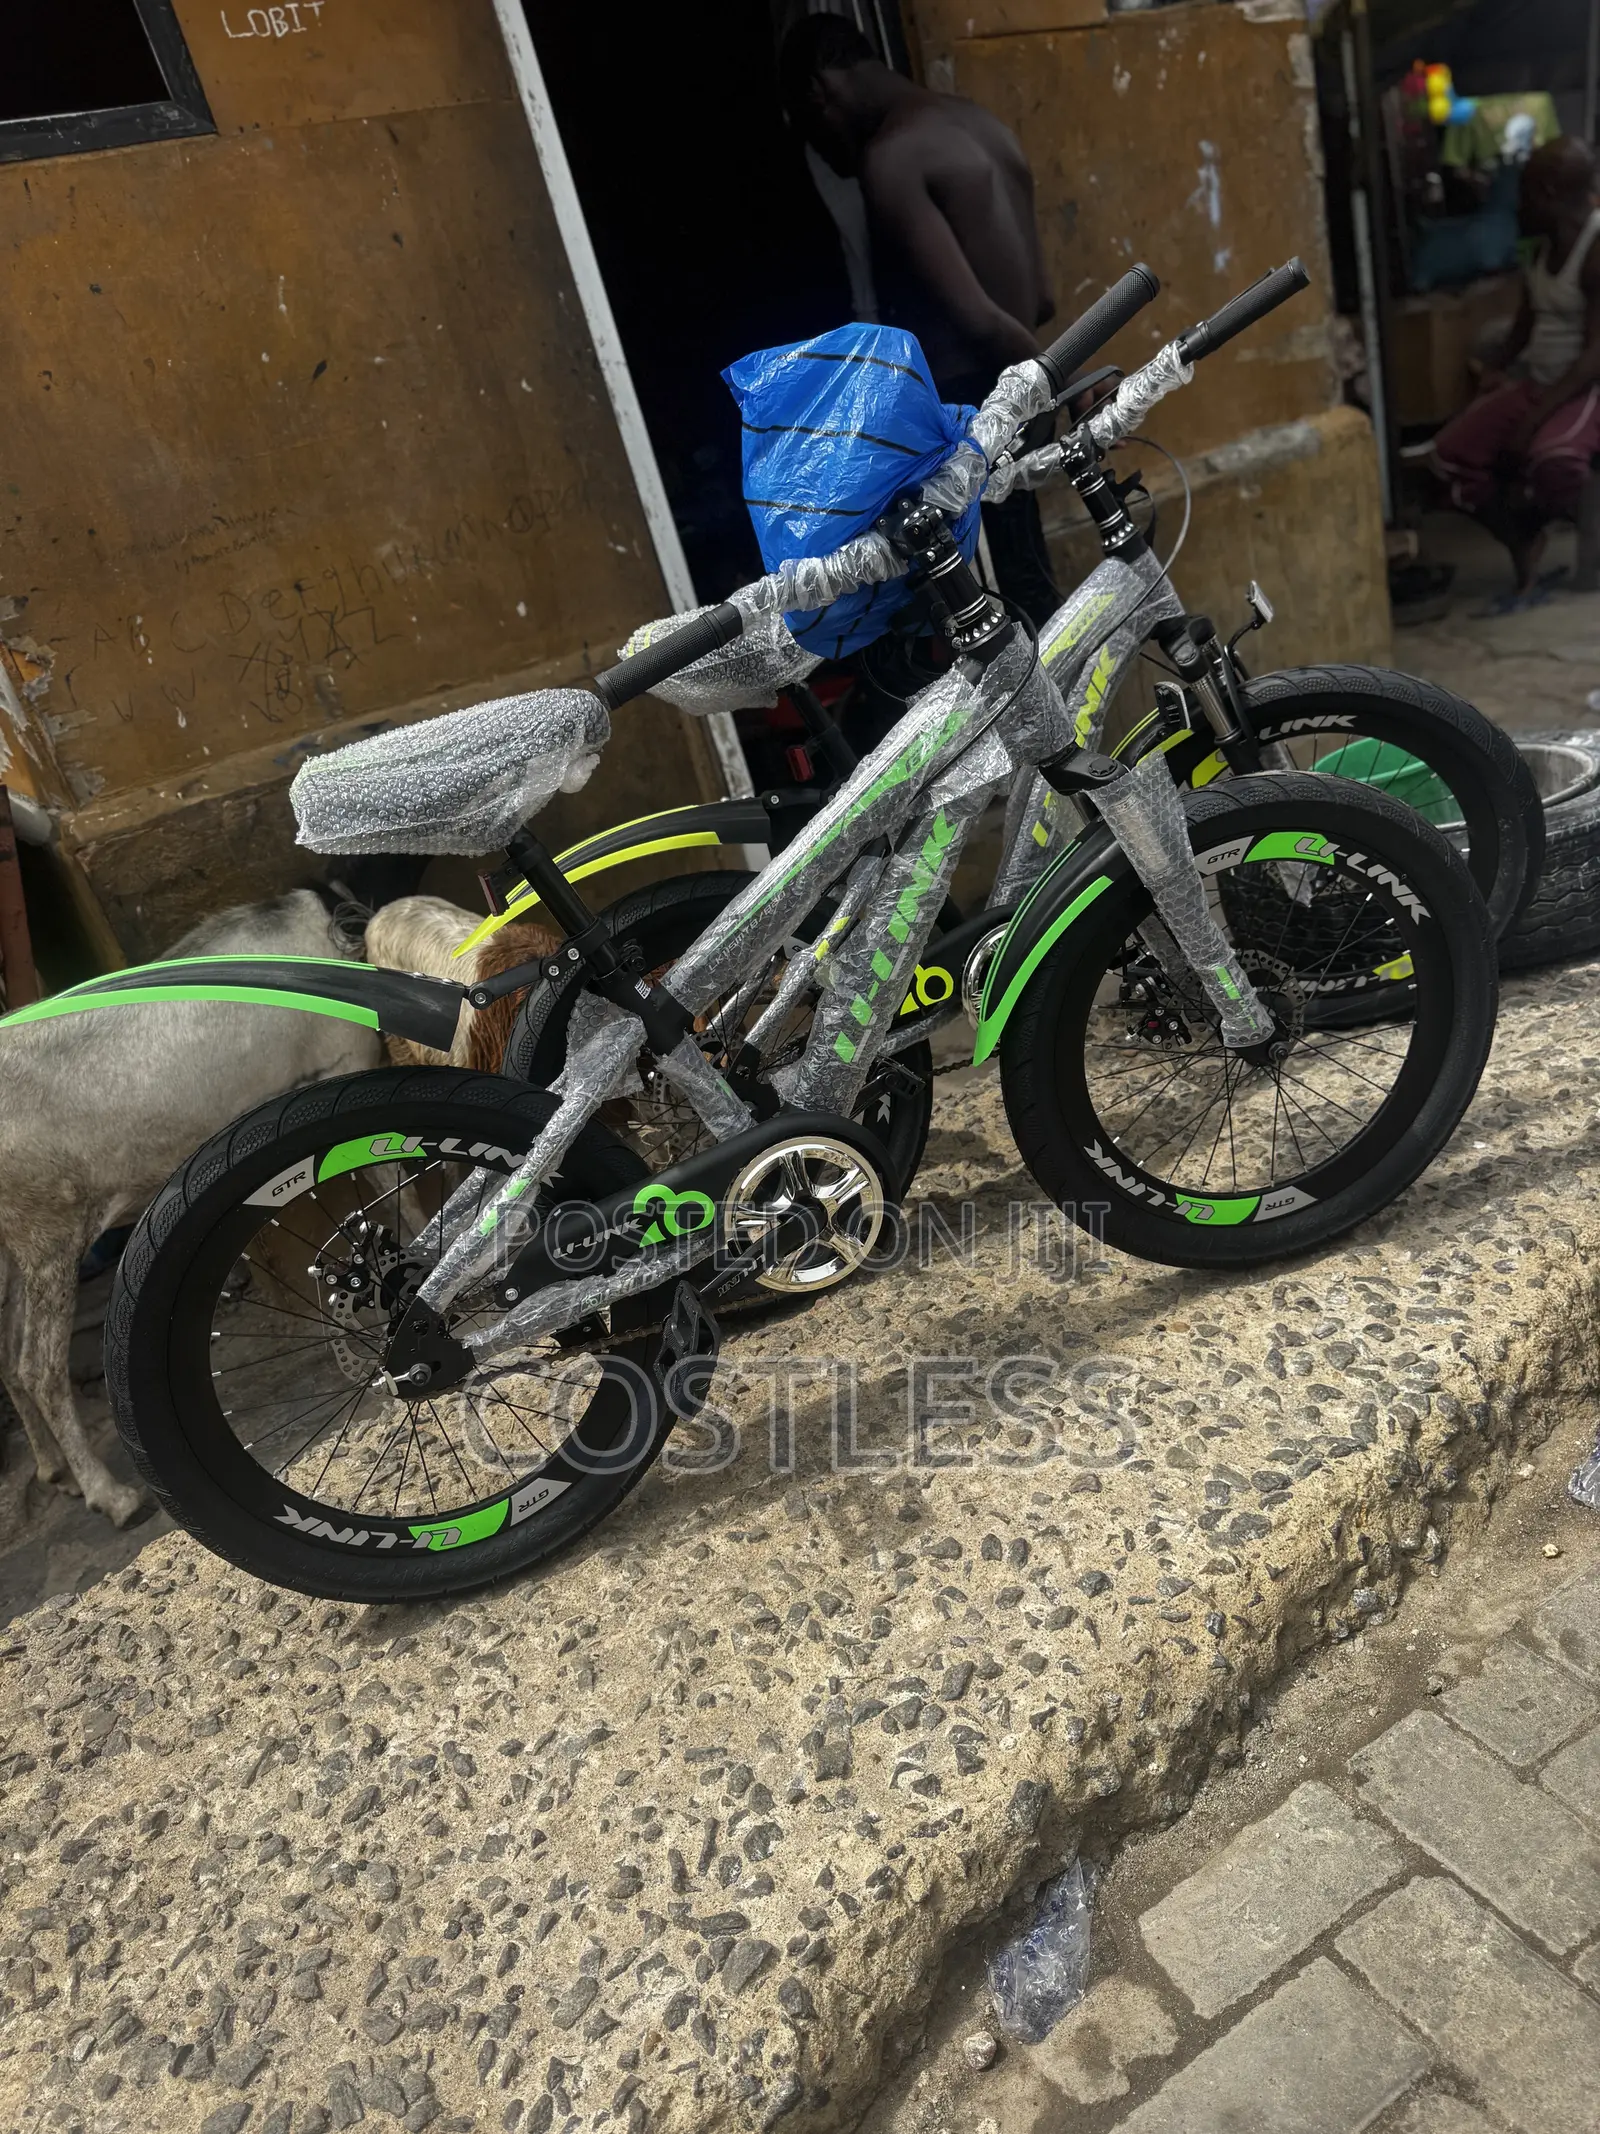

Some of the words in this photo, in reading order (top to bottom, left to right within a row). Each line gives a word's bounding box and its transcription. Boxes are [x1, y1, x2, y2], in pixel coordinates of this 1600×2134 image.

[1206, 847, 1241, 865] GTR
[271, 1170, 308, 1198] GTR
[632, 1183, 716, 1249] 20
[1264, 1196, 1296, 1211] GTR
[517, 1487, 550, 1514] GTR
